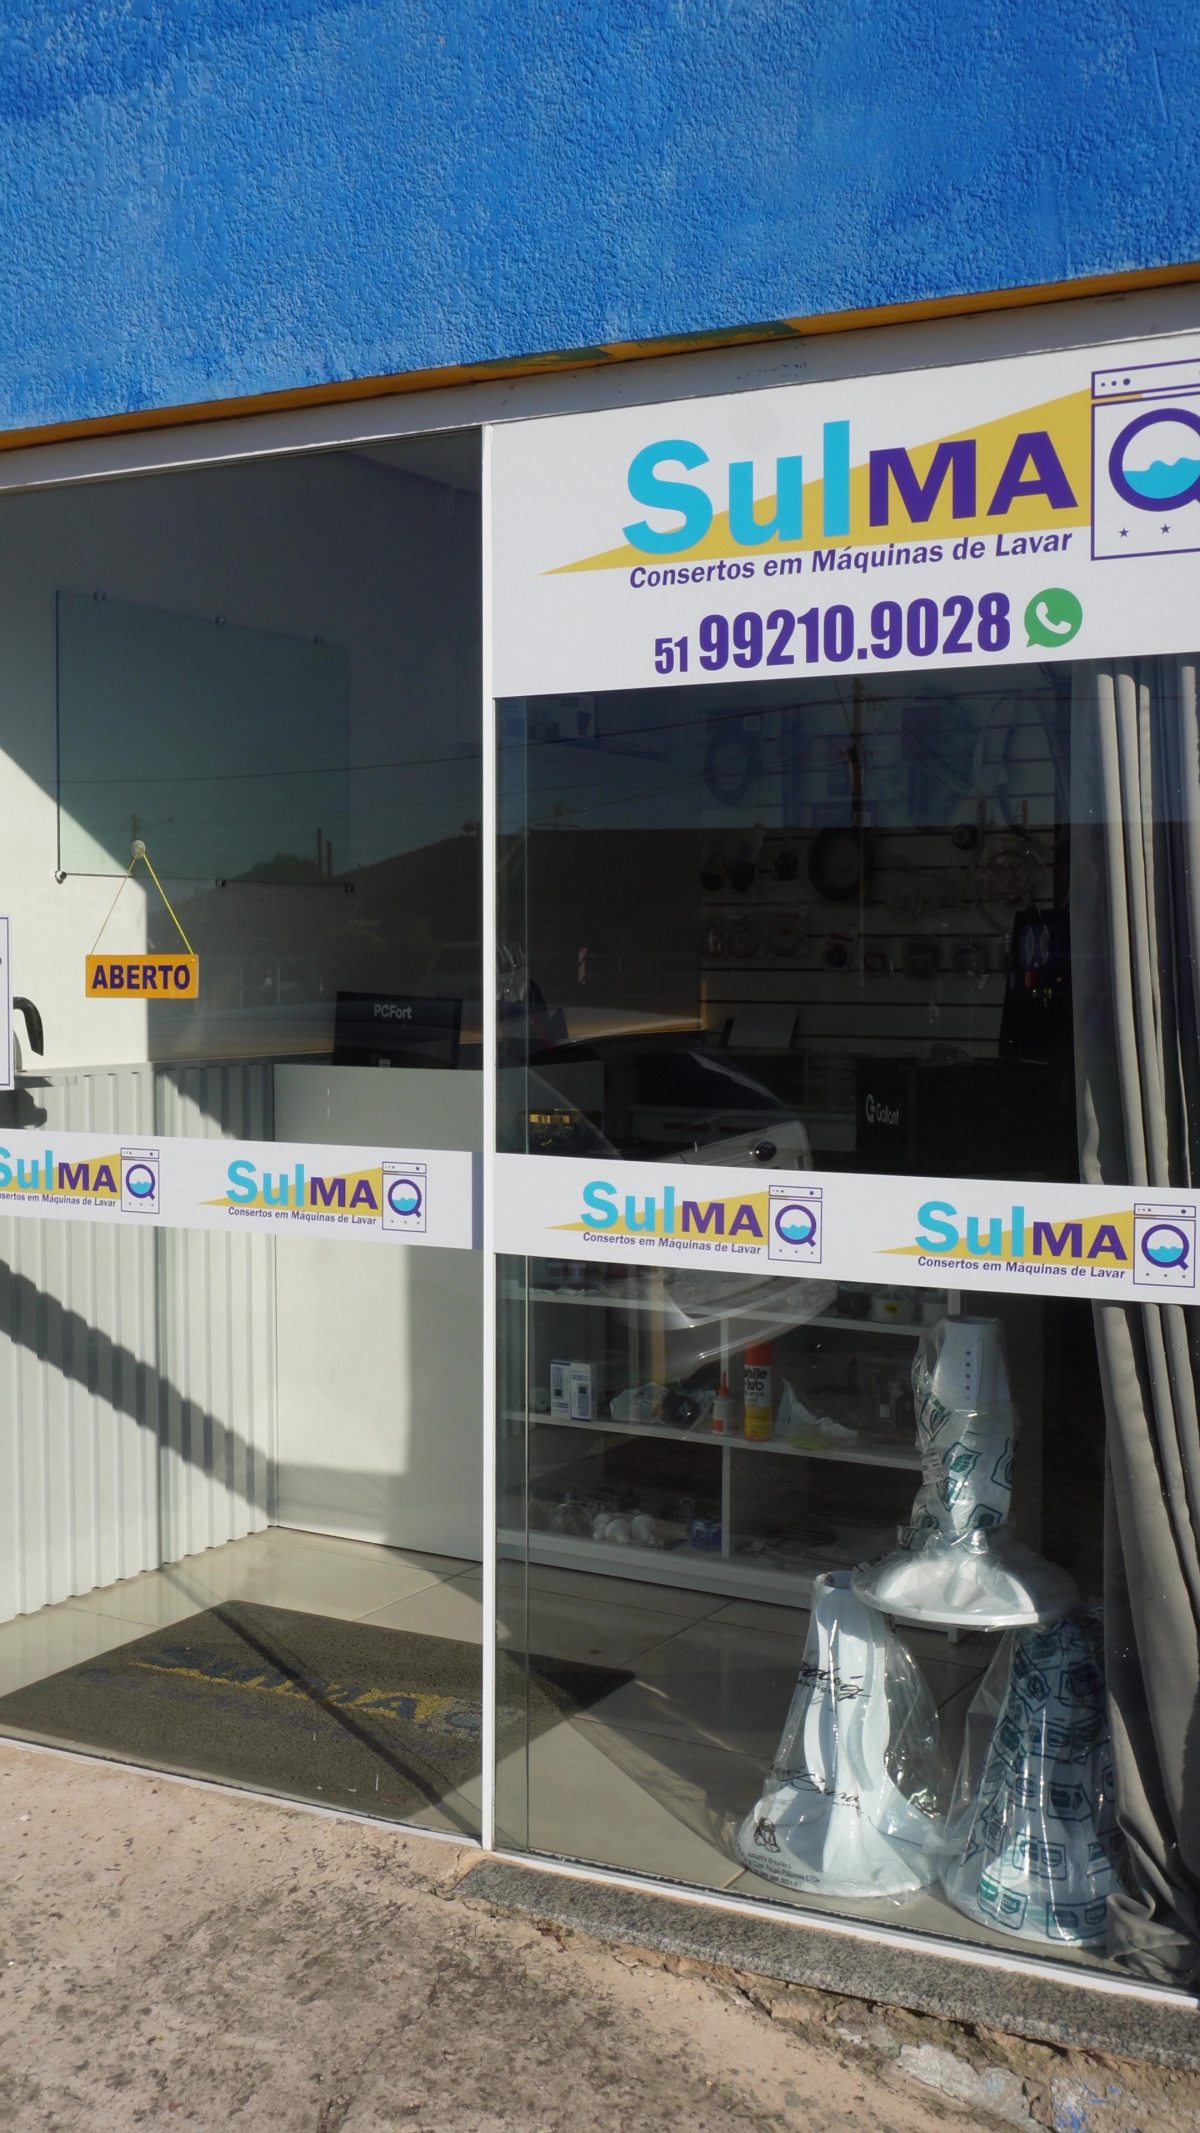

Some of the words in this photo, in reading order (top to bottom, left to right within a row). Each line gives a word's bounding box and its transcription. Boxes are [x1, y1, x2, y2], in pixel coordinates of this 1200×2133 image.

[629, 562, 755, 589] Consertos
[763, 557, 802, 577] em
[812, 545, 943, 573] Máquinas
[952, 538, 985, 561] de
[996, 533, 1073, 557] Lavar
[655, 637, 688, 674] 51
[699, 592, 1011, 673] 99210.9028
[92, 964, 190, 989] ABERTO
[28, 1195, 39, 1203] em
[42, 1193, 80, 1206] Máquinas
[82, 1197, 92, 1206] de
[94, 1199, 116, 1208] Lavar
[228, 1206, 272, 1219] Consertos
[275, 1211, 289, 1220] em
[291, 1209, 335, 1223] Máquinas
[337, 1214, 349, 1224] de
[351, 1216, 377, 1226] Lavar
[583, 1231, 636, 1246] Consertos
[639, 1237, 655, 1247] em
[658, 1236, 711, 1252] Máquinas
[714, 1241, 728, 1253] de
[731, 1243, 762, 1255] Lavar
[917, 1255, 979, 1271] Consertos
[982, 1262, 1002, 1273] em
[1006, 1260, 1068, 1277] Máquinas
[1070, 1265, 1087, 1278] de
[1090, 1266, 1126, 1280] Lavar
